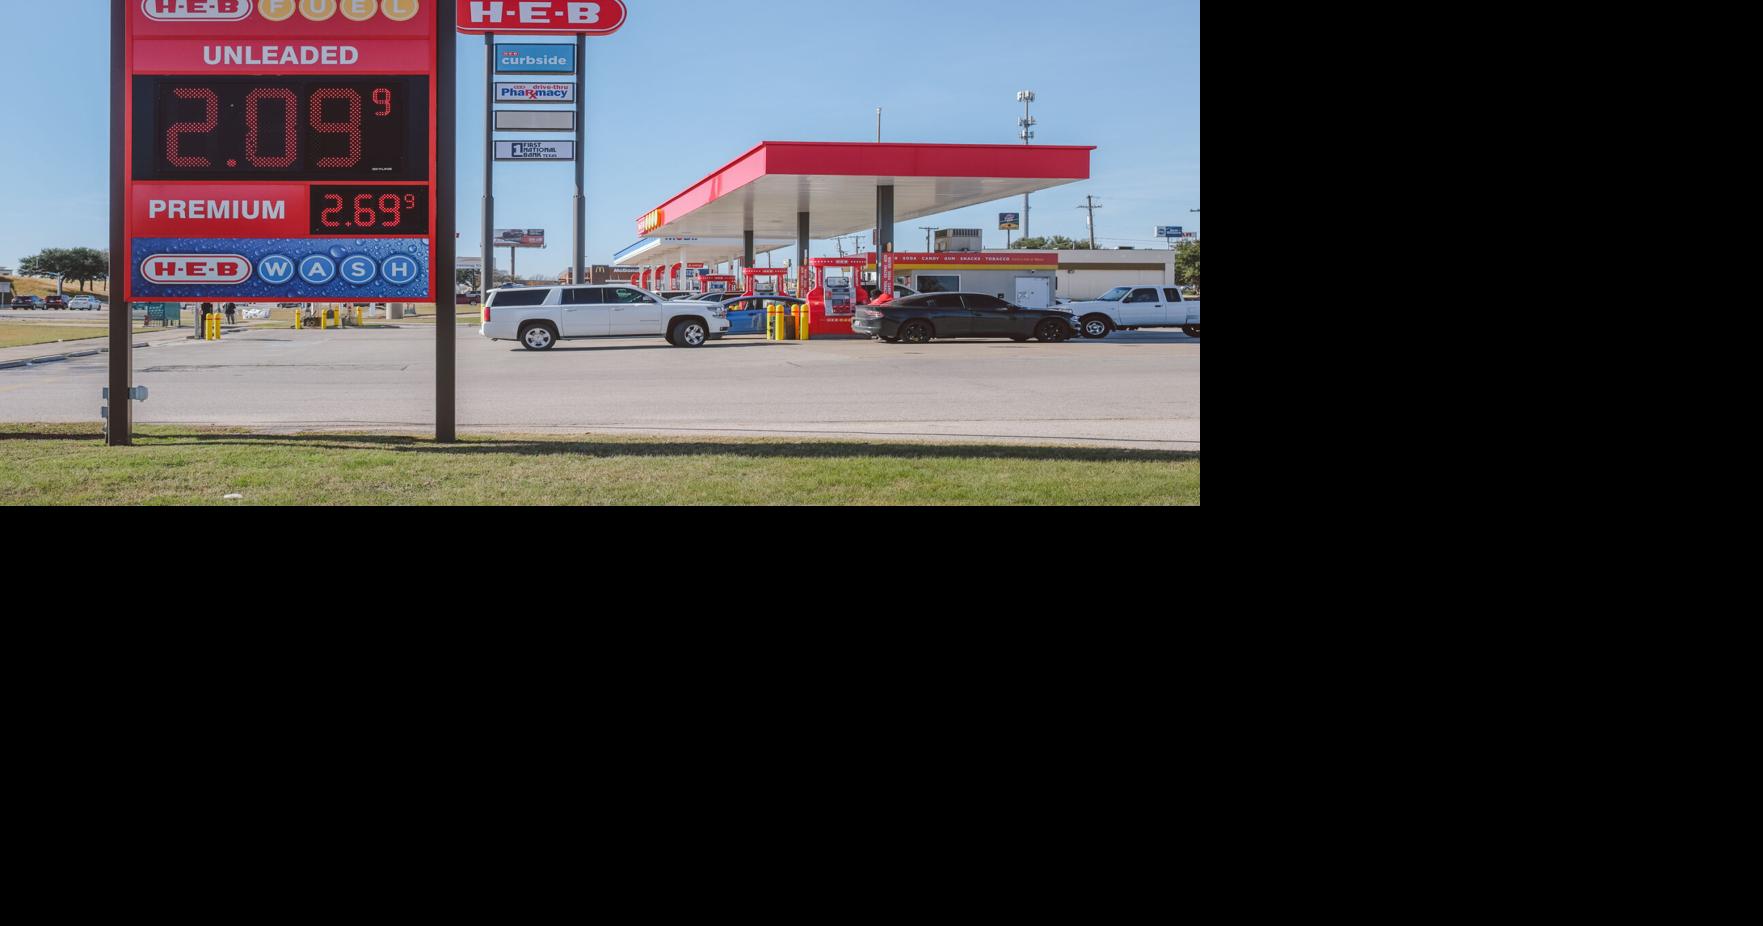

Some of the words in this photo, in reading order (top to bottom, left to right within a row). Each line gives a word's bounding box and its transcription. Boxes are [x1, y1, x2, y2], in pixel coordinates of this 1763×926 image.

[155, 0, 240, 13] H-E-B
[269, 0, 405, 14] FUEL
[469, 1, 602, 24] H-E-B
[203, 45, 359, 65] UNLEADED
[501, 55, 567, 65] curbside
[148, 199, 286, 221] PREMIUM
[154, 261, 240, 277] H-E-B
[264, 261, 409, 278] WASH
